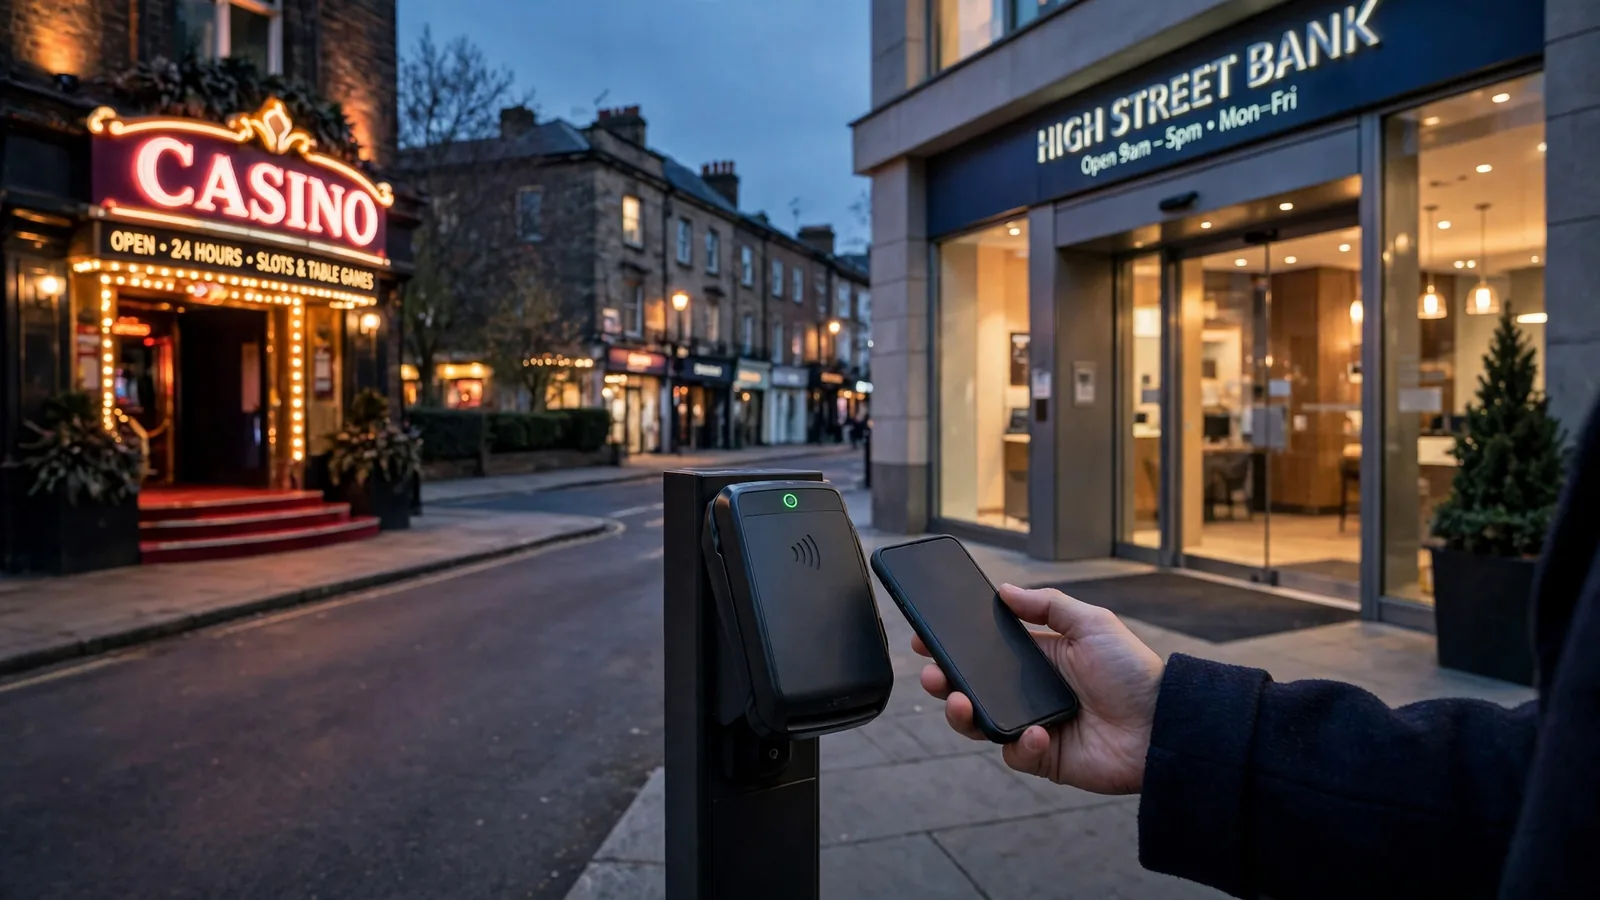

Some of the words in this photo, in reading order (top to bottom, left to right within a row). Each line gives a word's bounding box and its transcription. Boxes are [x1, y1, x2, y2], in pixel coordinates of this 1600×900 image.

[1037, 107, 1104, 163] HIGH
[1110, 54, 1237, 138] STREET
[1246, 0, 1380, 89] BANK
[135, 136, 379, 246] CASINO
[1081, 151, 1117, 177] Open
[1118, 139, 1151, 164] 9am
[1165, 122, 1203, 151] 5pm
[110, 230, 156, 256] OPEN
[170, 238, 192, 260] 24
[194, 241, 243, 268] HOURS
[256, 251, 295, 276] SLOTS
[296, 258, 307, 278] &
[307, 260, 340, 284] TABLE
[340, 267, 374, 291] GAMES
